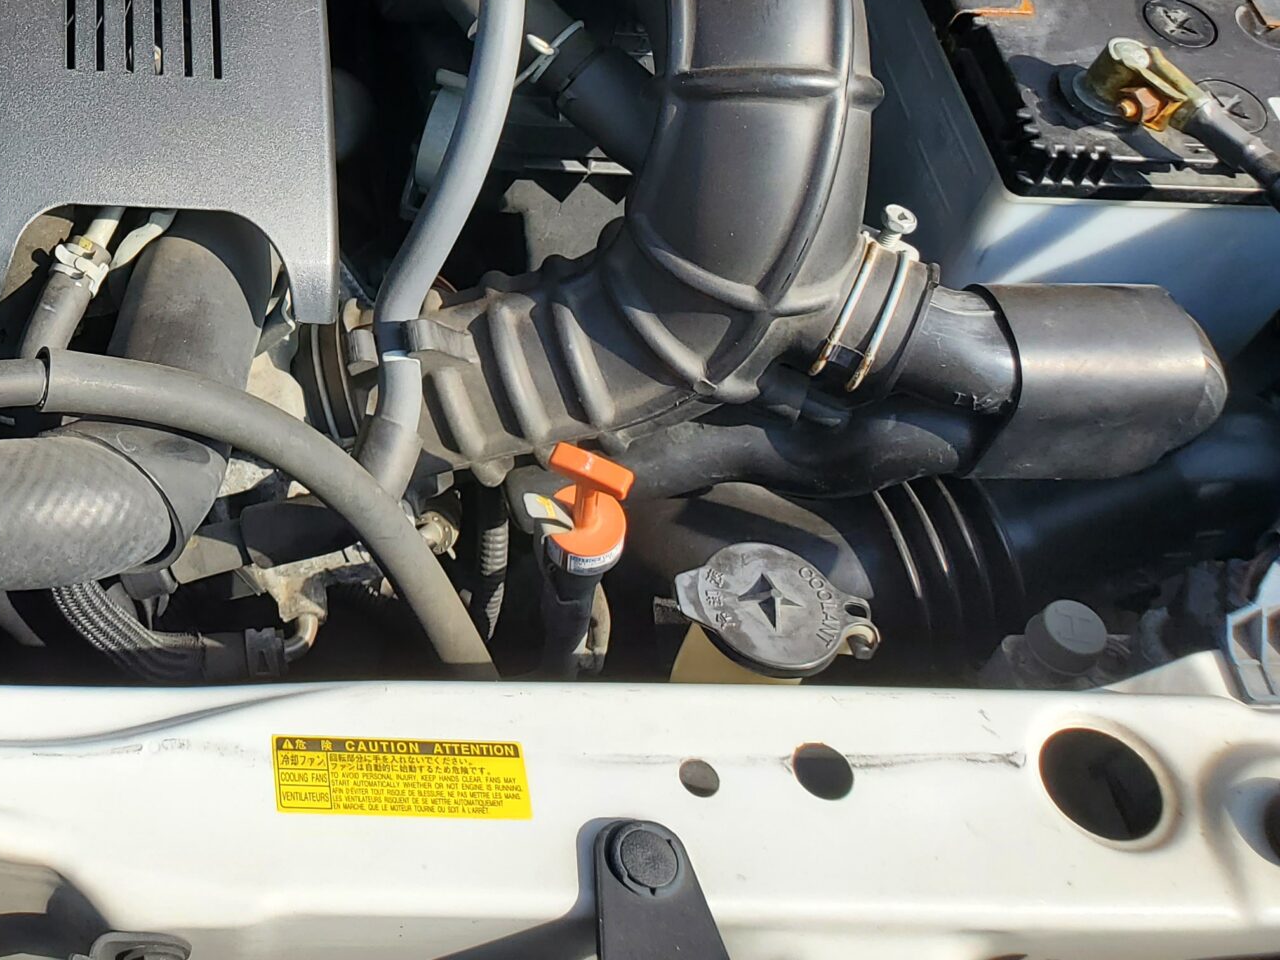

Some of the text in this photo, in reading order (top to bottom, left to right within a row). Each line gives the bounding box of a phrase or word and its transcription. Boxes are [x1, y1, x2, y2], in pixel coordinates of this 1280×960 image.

[798, 566, 842, 650] COOLANT
[344, 740, 515, 757] CAUTION ATTENTION
[280, 754, 326, 767] 冷却ファン
[280, 772, 328, 784] COOLING FANS
[439, 775, 460, 783] HANDS
[485, 776, 502, 784] FANS
[352, 780, 400, 788] AUTOMATICALLY
[435, 782, 444, 790] OR
[281, 791, 330, 803] VENTILATEURS
[457, 791, 468, 799] PAS
[492, 792, 502, 800] LES
